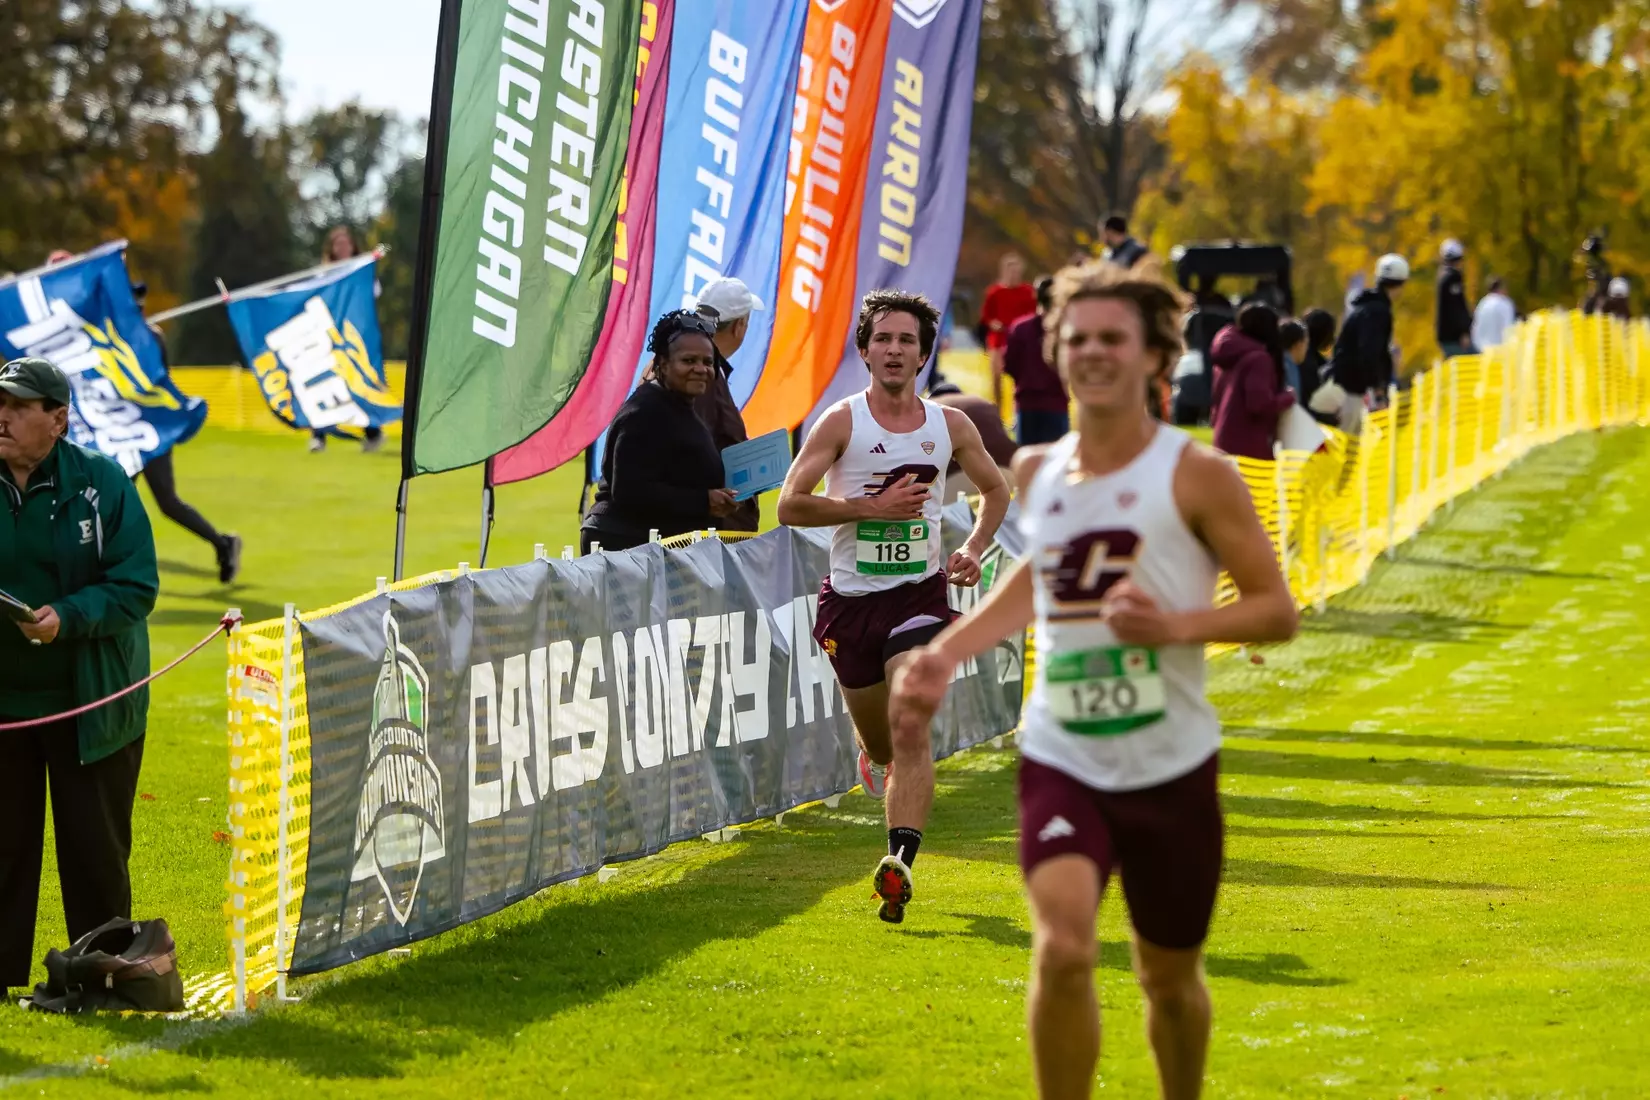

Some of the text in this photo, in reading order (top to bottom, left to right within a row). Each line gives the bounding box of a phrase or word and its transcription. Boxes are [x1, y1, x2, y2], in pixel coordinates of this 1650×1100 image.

[471, 0, 549, 348] MICHIGAN
[681, 30, 748, 312] BUFFAL
[791, 21, 856, 313] BOWLING
[878, 57, 924, 267] AKRON
[874, 563, 910, 573] LUCAS
[875, 543, 910, 562] 118
[1070, 680, 1138, 718] 120
